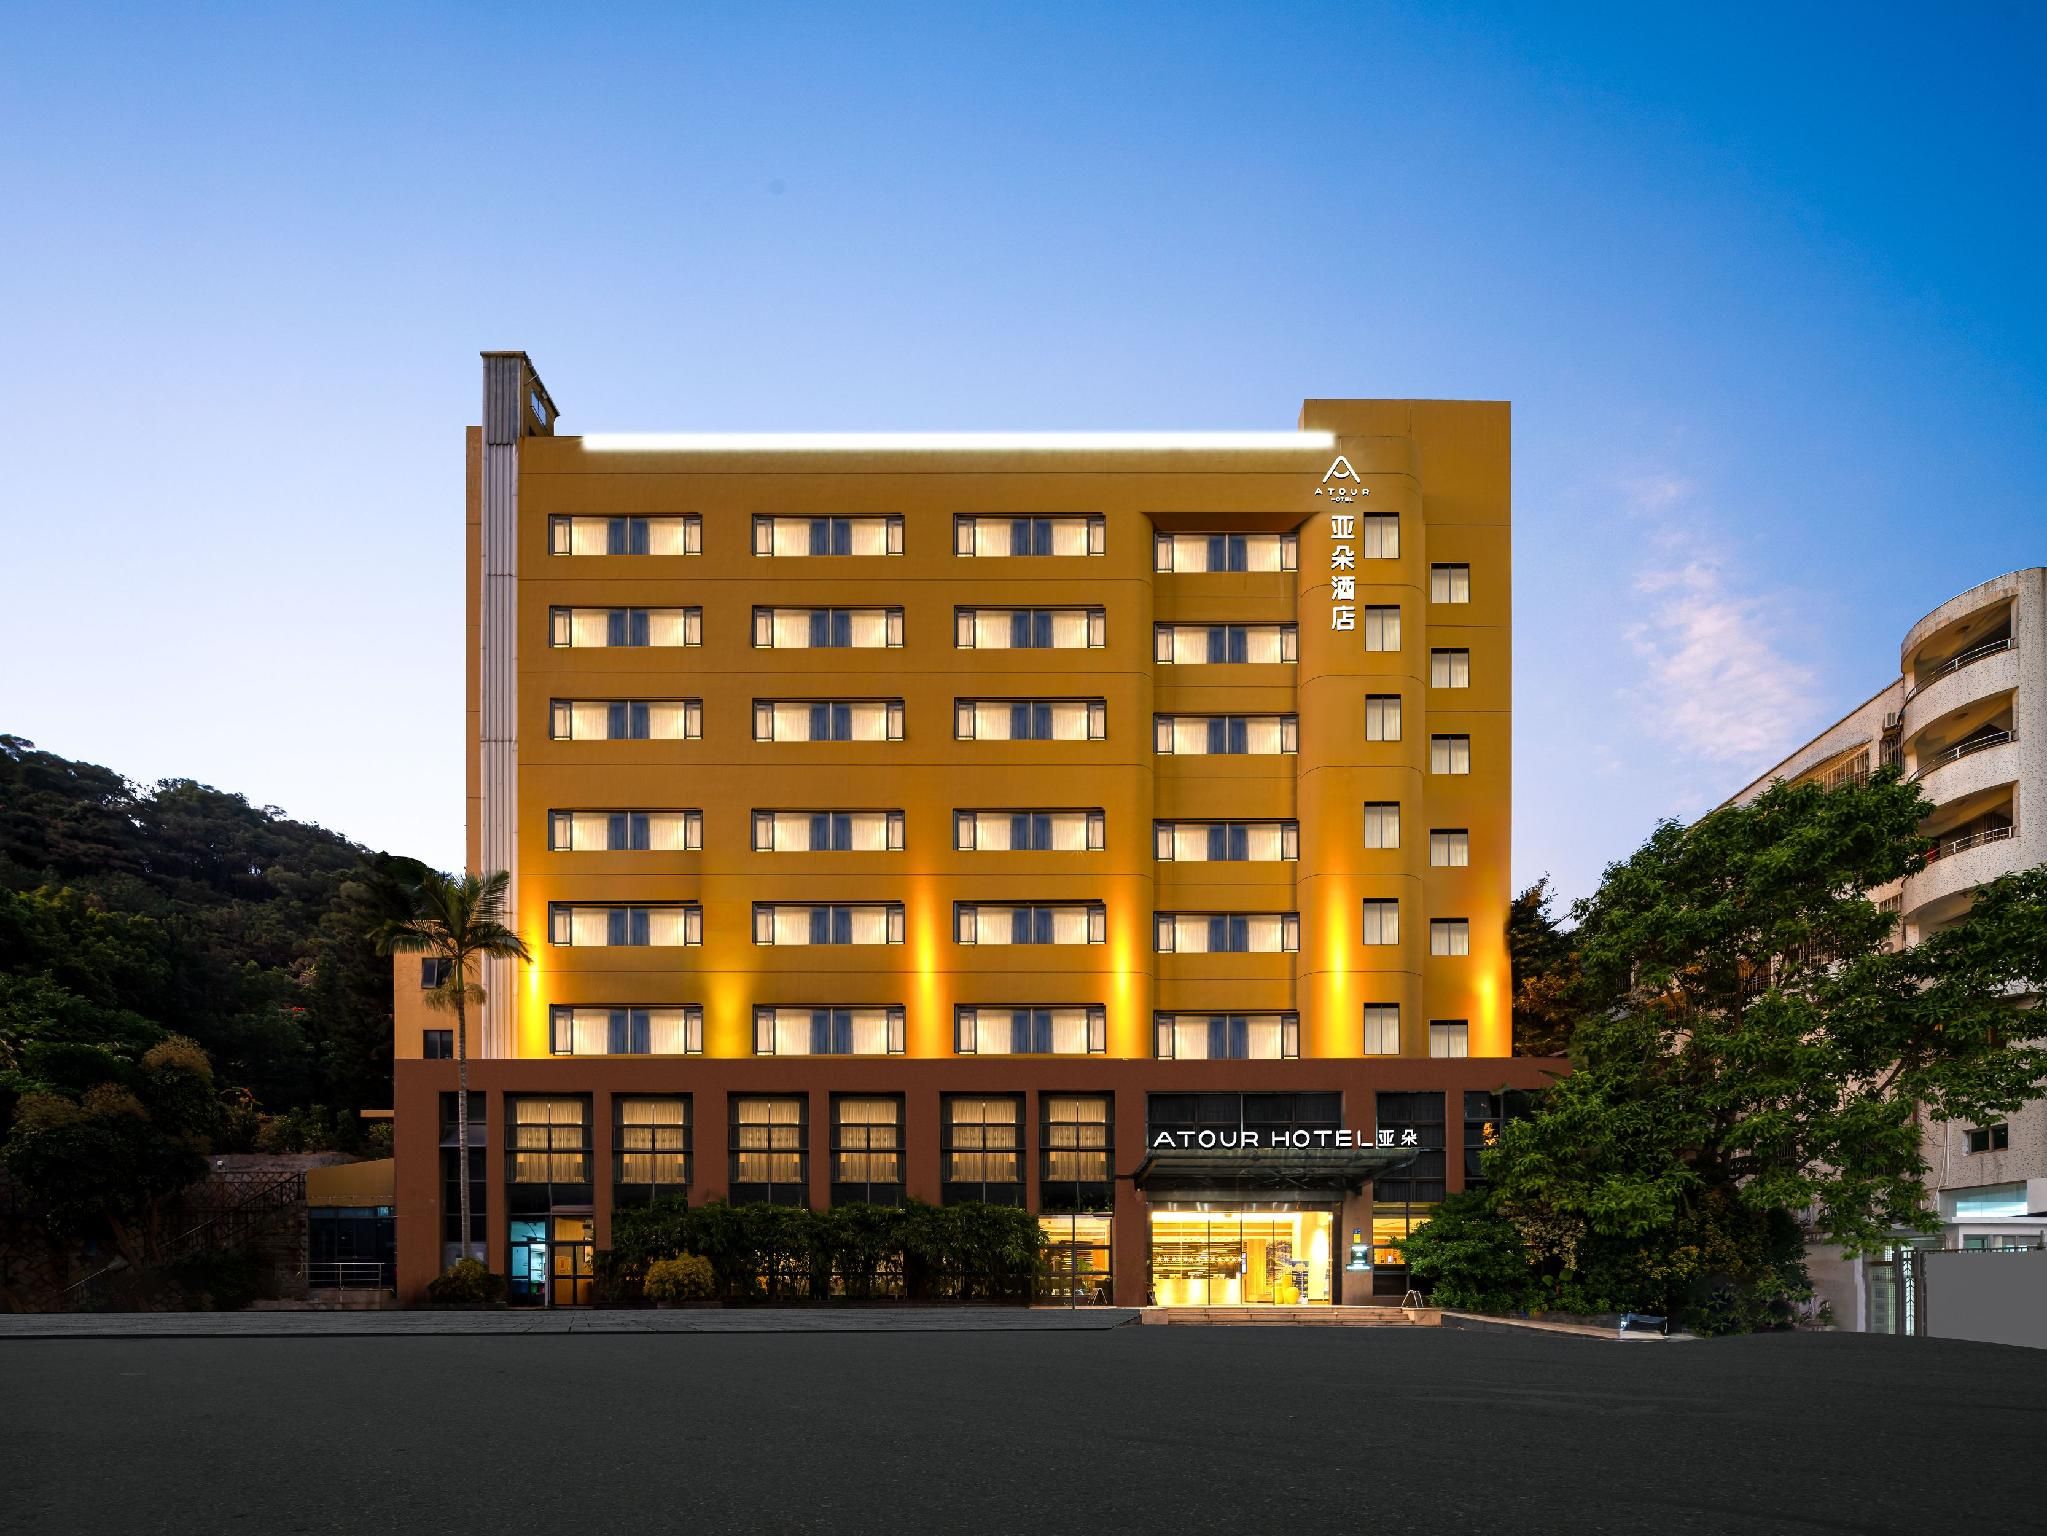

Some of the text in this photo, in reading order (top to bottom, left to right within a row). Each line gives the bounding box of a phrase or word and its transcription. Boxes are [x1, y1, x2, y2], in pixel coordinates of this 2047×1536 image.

[1314, 487, 1370, 496] ATOUR
[1331, 515, 1355, 631] 亚朵酒店
[1153, 1129, 1418, 1148] ATOUR HOTEL 亚朵
